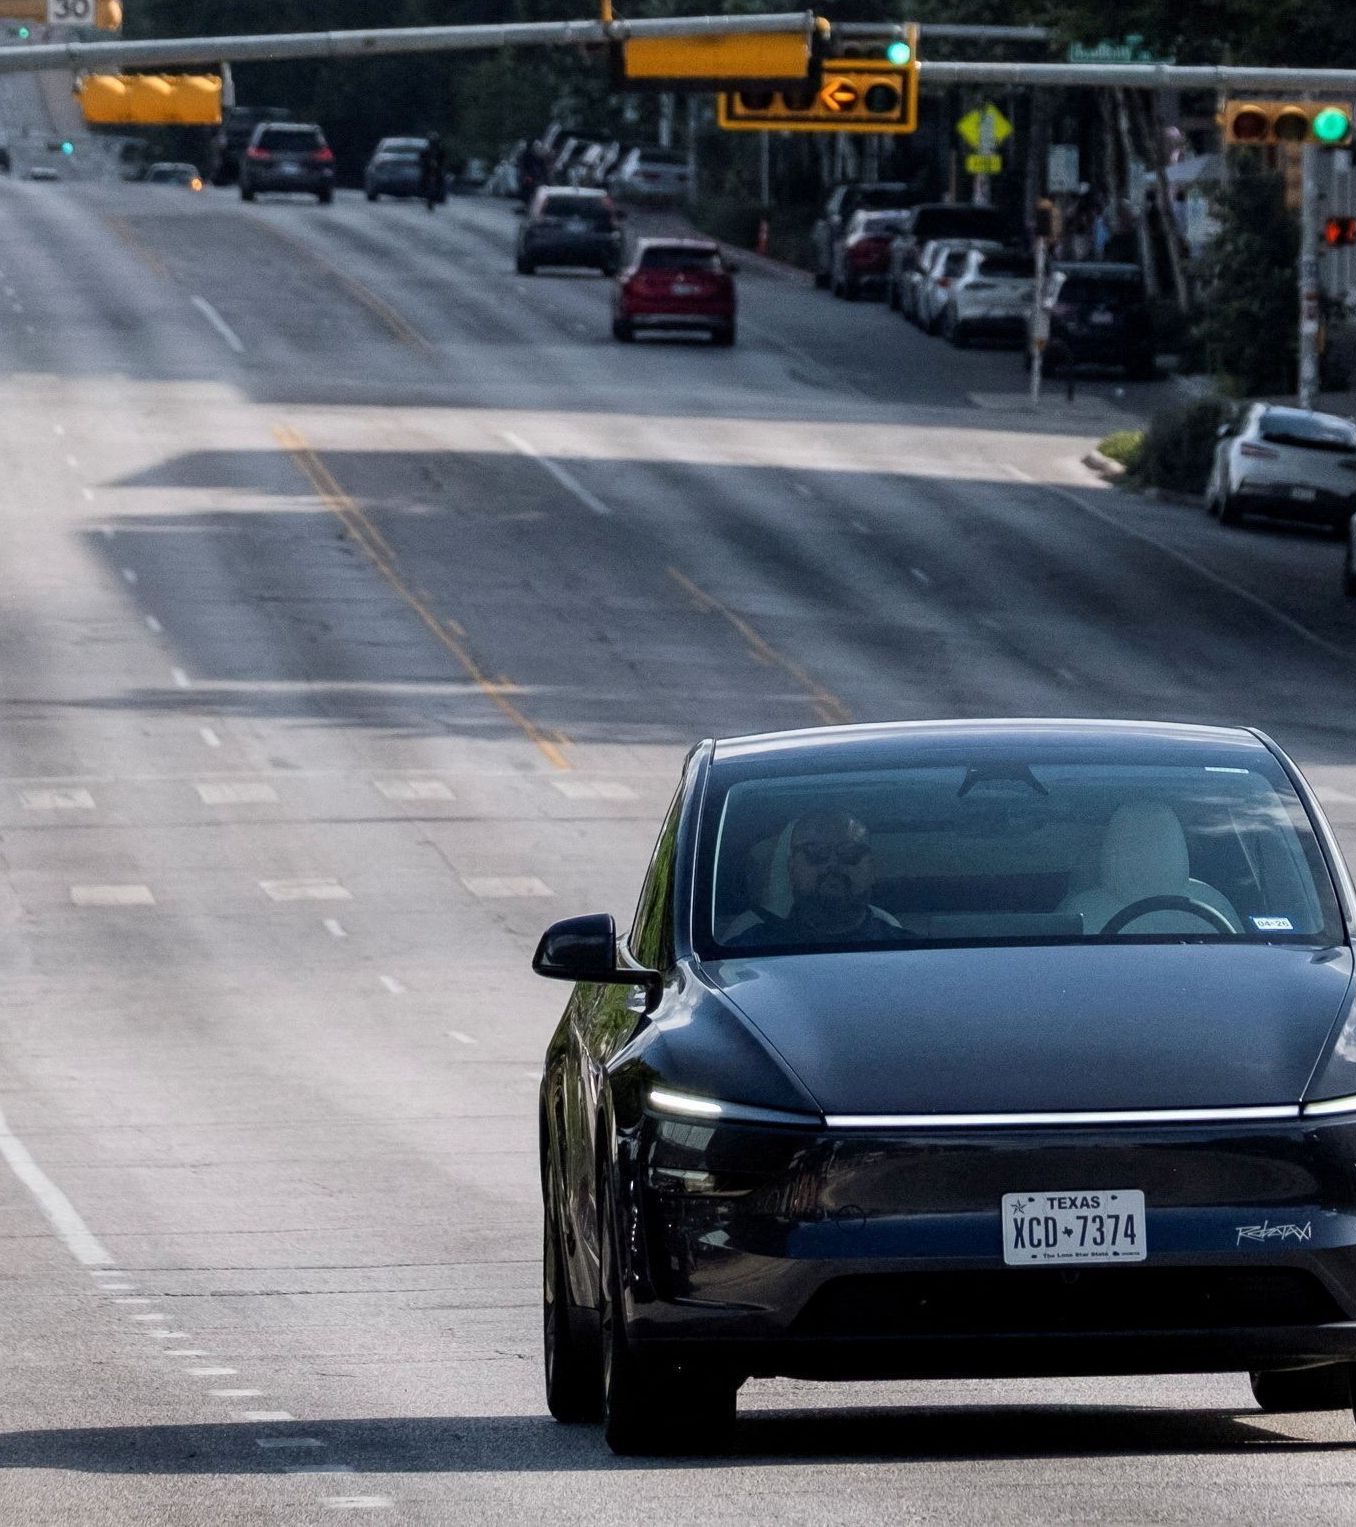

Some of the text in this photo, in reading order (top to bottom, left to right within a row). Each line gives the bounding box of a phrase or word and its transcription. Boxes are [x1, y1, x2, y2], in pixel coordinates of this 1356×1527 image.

[55, 0, 89, 18] 30
[1047, 1196, 1101, 1210] TEXAS
[1013, 1214, 1136, 1249] XCD 7374
